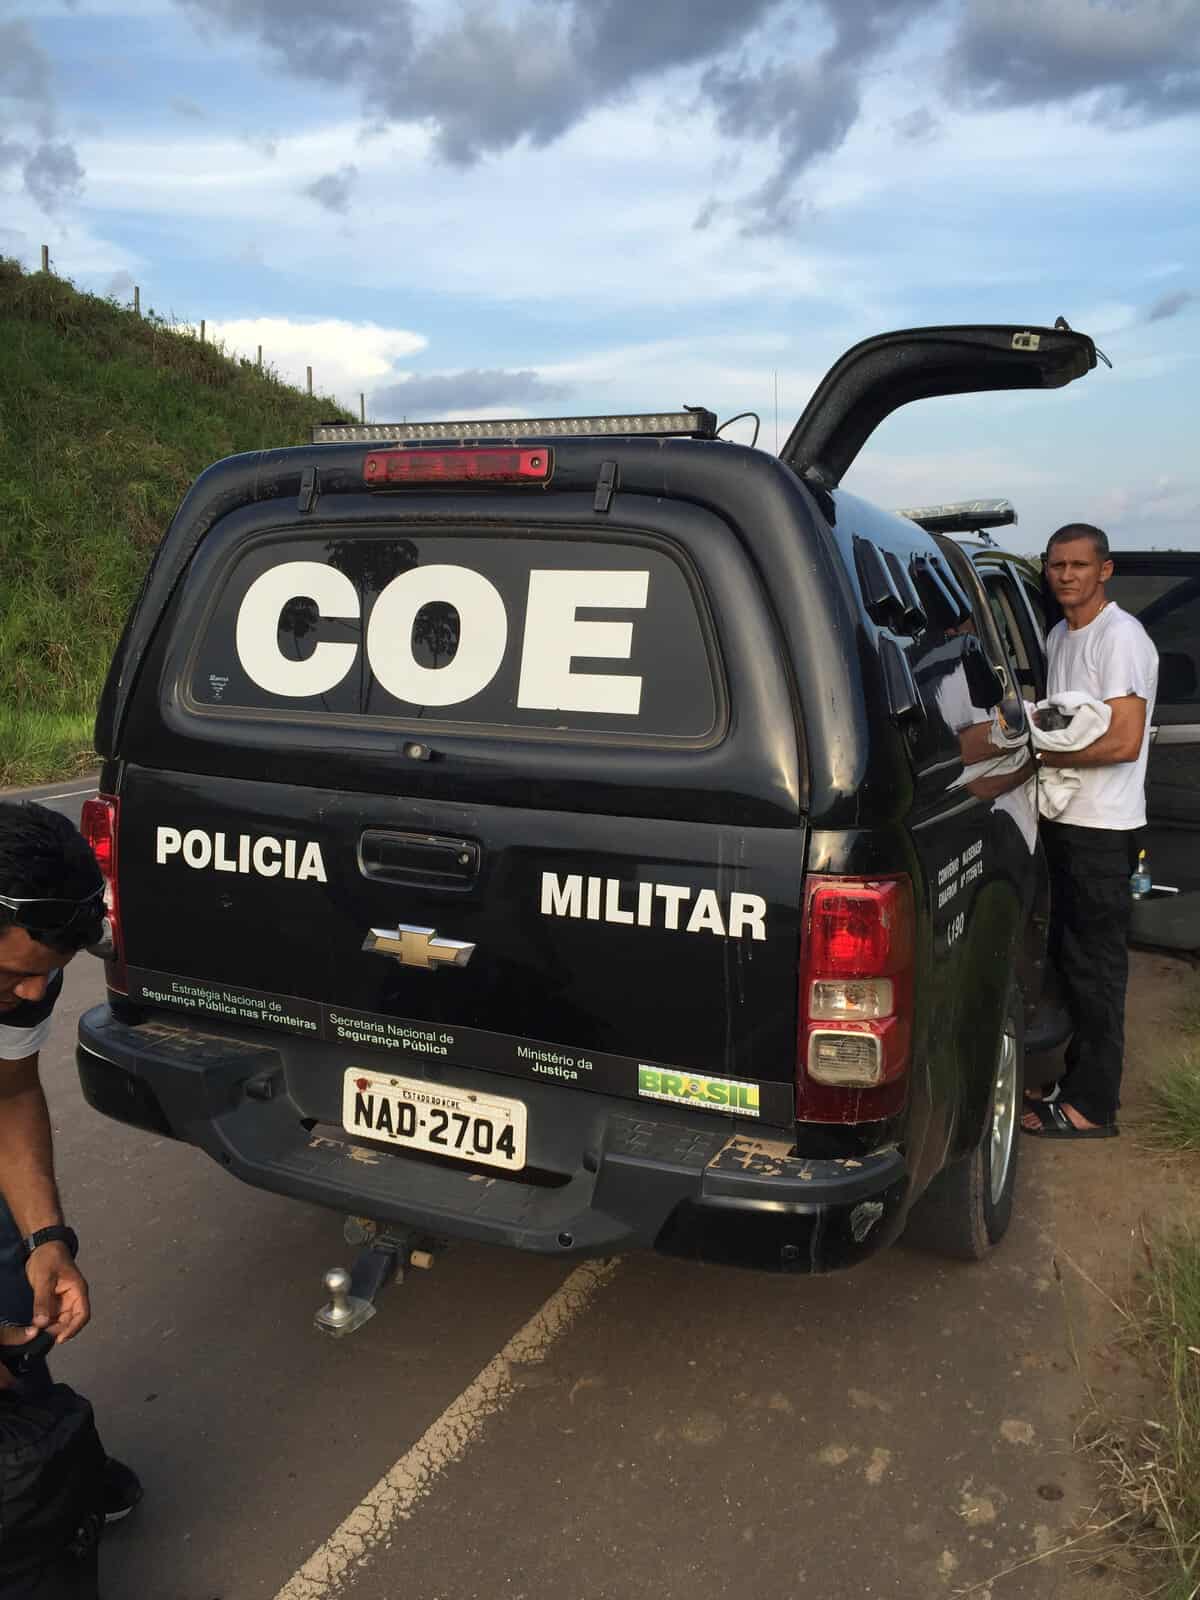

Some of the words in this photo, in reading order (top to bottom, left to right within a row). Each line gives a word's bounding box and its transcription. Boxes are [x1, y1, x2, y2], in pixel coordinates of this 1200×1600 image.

[236, 561, 650, 715] COE
[156, 826, 328, 883] POLICIA
[541, 872, 767, 941] MILITAR
[142, 987, 196, 1008] Segurança
[198, 998, 237, 1015] Pública
[239, 1006, 259, 1020] nas
[262, 1010, 317, 1030] Fronteiras
[171, 982, 221, 1001] Estratégia
[223, 990, 267, 1009] Nacional
[268, 999, 282, 1012] de
[330, 1013, 384, 1033] Secretaria
[388, 1023, 437, 1042] Nacional
[439, 1032, 454, 1045] de
[337, 1026, 400, 1049] Segurança
[403, 1037, 447, 1055] Pública
[517, 1046, 573, 1067] Ministério
[577, 1058, 593, 1071] da
[532, 1062, 578, 1080] Justiça
[639, 1069, 759, 1110] BRASIL
